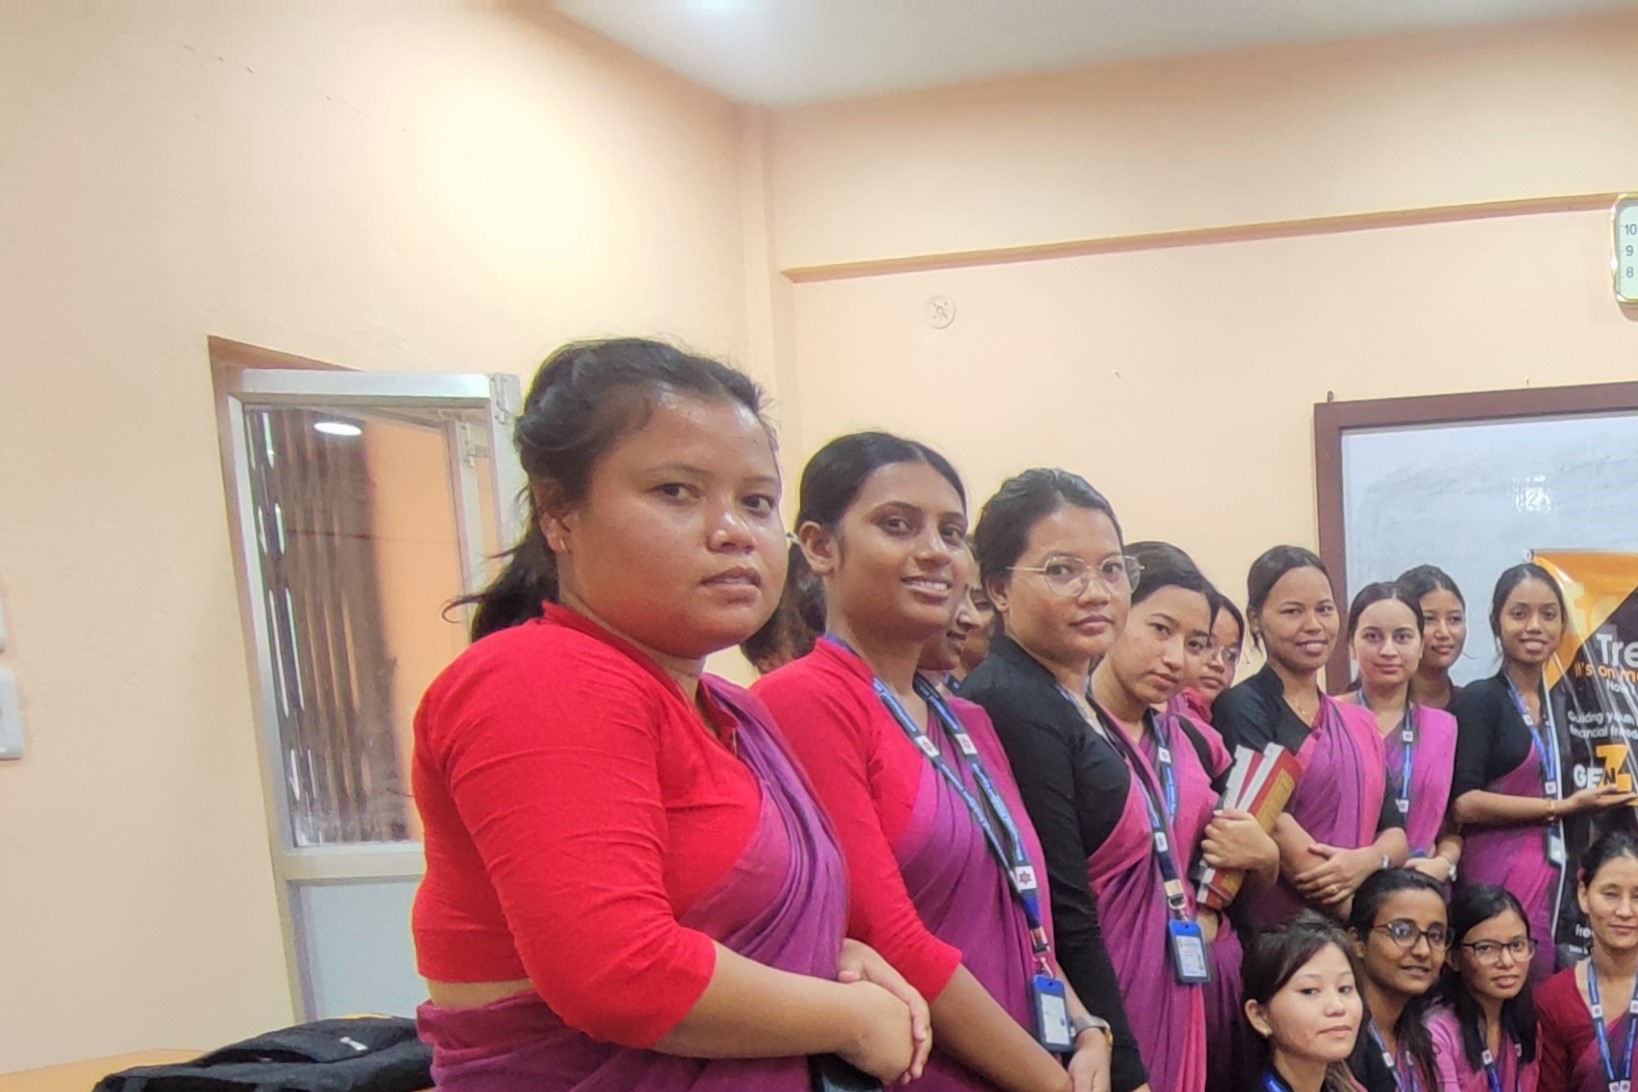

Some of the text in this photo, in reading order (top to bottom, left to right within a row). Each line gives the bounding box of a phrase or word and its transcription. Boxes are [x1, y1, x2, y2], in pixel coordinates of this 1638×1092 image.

[1624, 223, 1638, 236] 10
[1625, 244, 1634, 257] 9
[1626, 266, 1634, 278] 8
[1598, 664, 1616, 680] on
